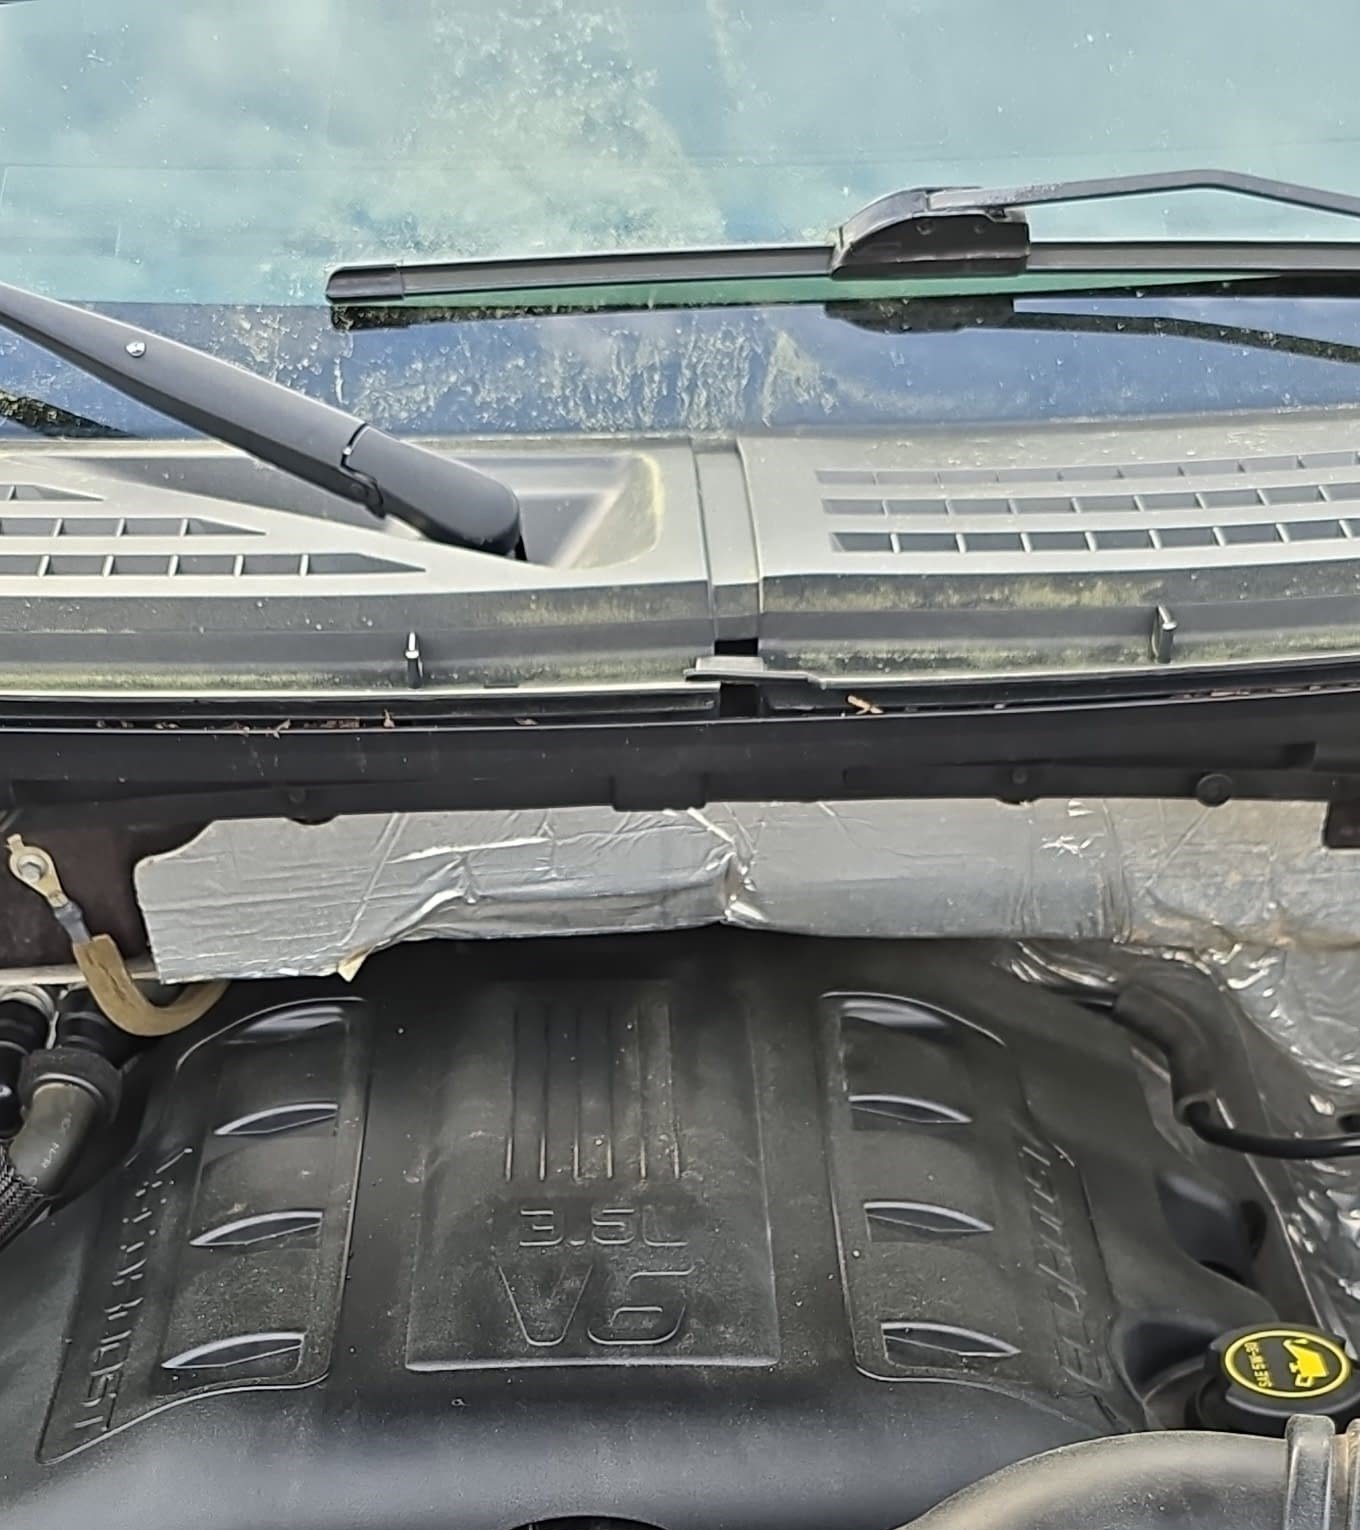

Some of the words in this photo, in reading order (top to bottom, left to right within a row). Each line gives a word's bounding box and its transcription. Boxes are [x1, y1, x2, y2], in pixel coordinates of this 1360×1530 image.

[516, 1204, 689, 1247] 3.5L
[492, 1260, 697, 1347] V6
[1253, 1369, 1274, 1388] SAE
